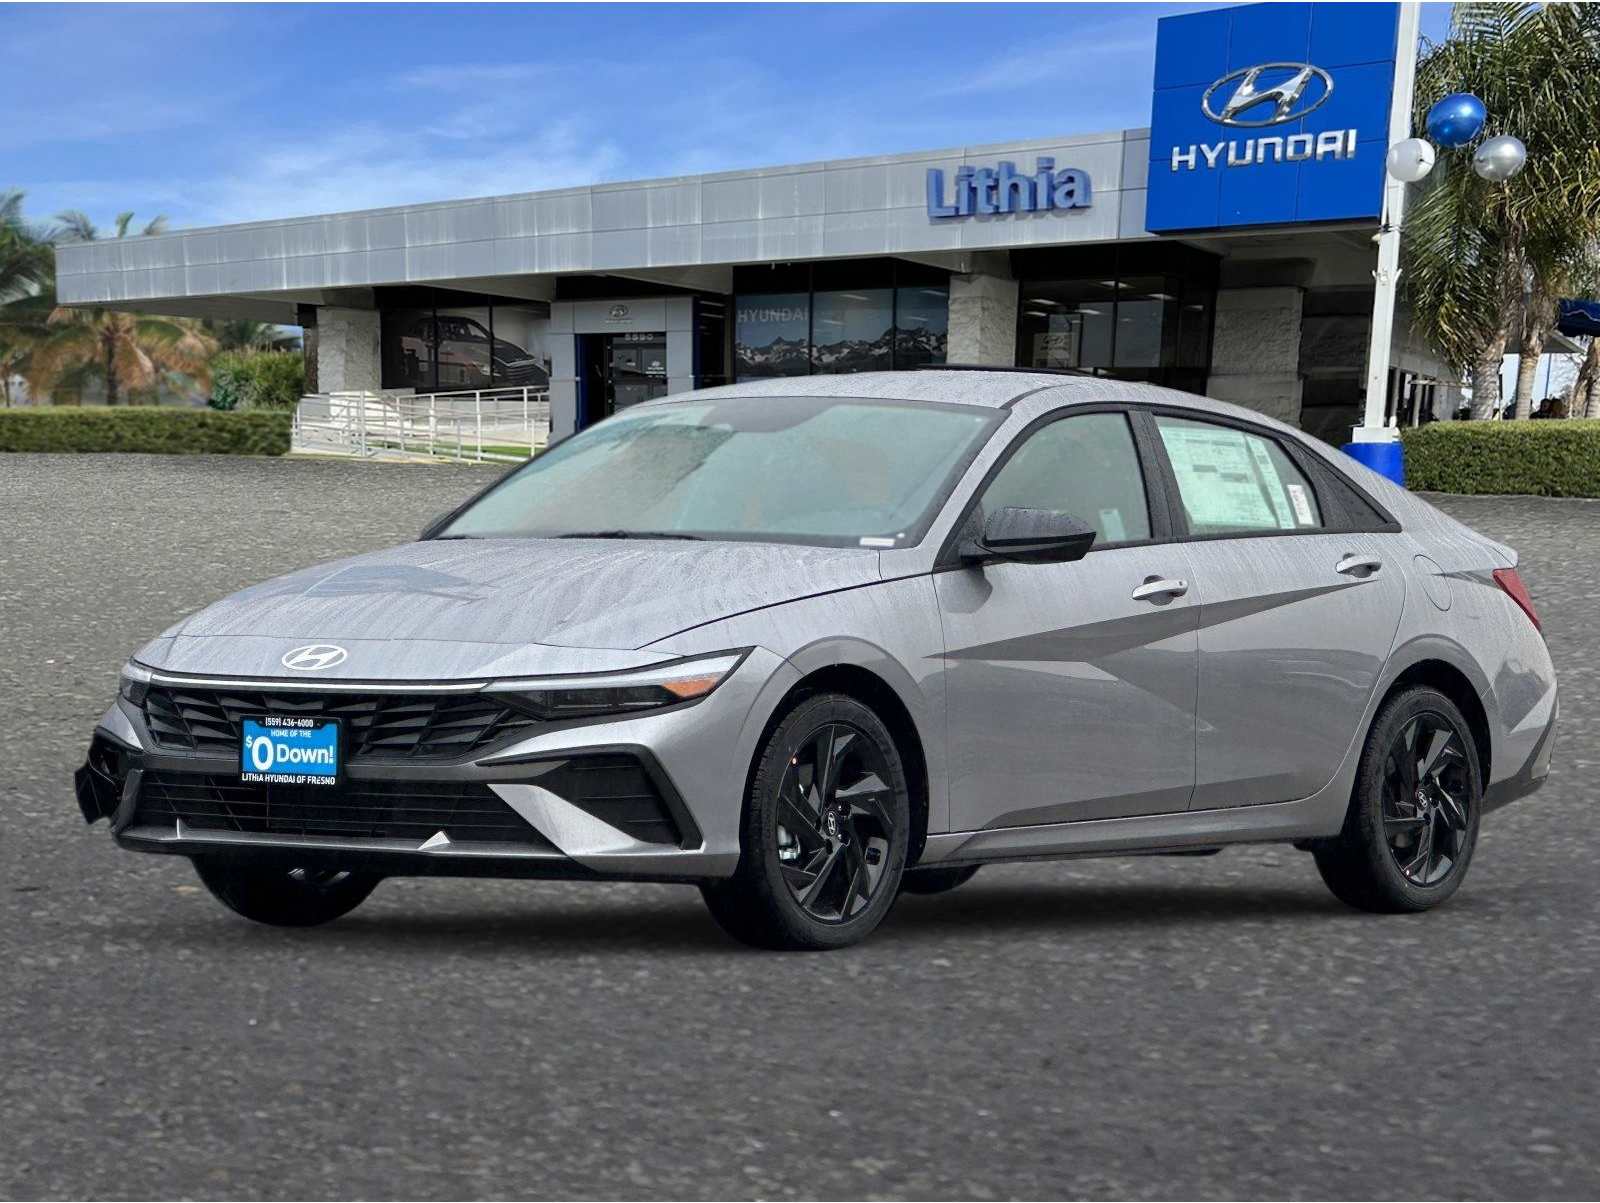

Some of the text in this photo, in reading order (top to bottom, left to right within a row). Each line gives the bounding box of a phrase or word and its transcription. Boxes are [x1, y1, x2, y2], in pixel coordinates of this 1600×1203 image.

[1171, 128, 1357, 171] HYUNDAI
[926, 157, 1092, 219] Lithia
[737, 308, 808, 322] HYUNDAI
[265, 717, 314, 728] (559) 436-6000
[270, 729, 289, 737] HOME
[299, 730, 312, 738] THE
[276, 743, 334, 764] Down!
[241, 773, 336, 785] LITHIA HYUNDAI OF FRESNO
